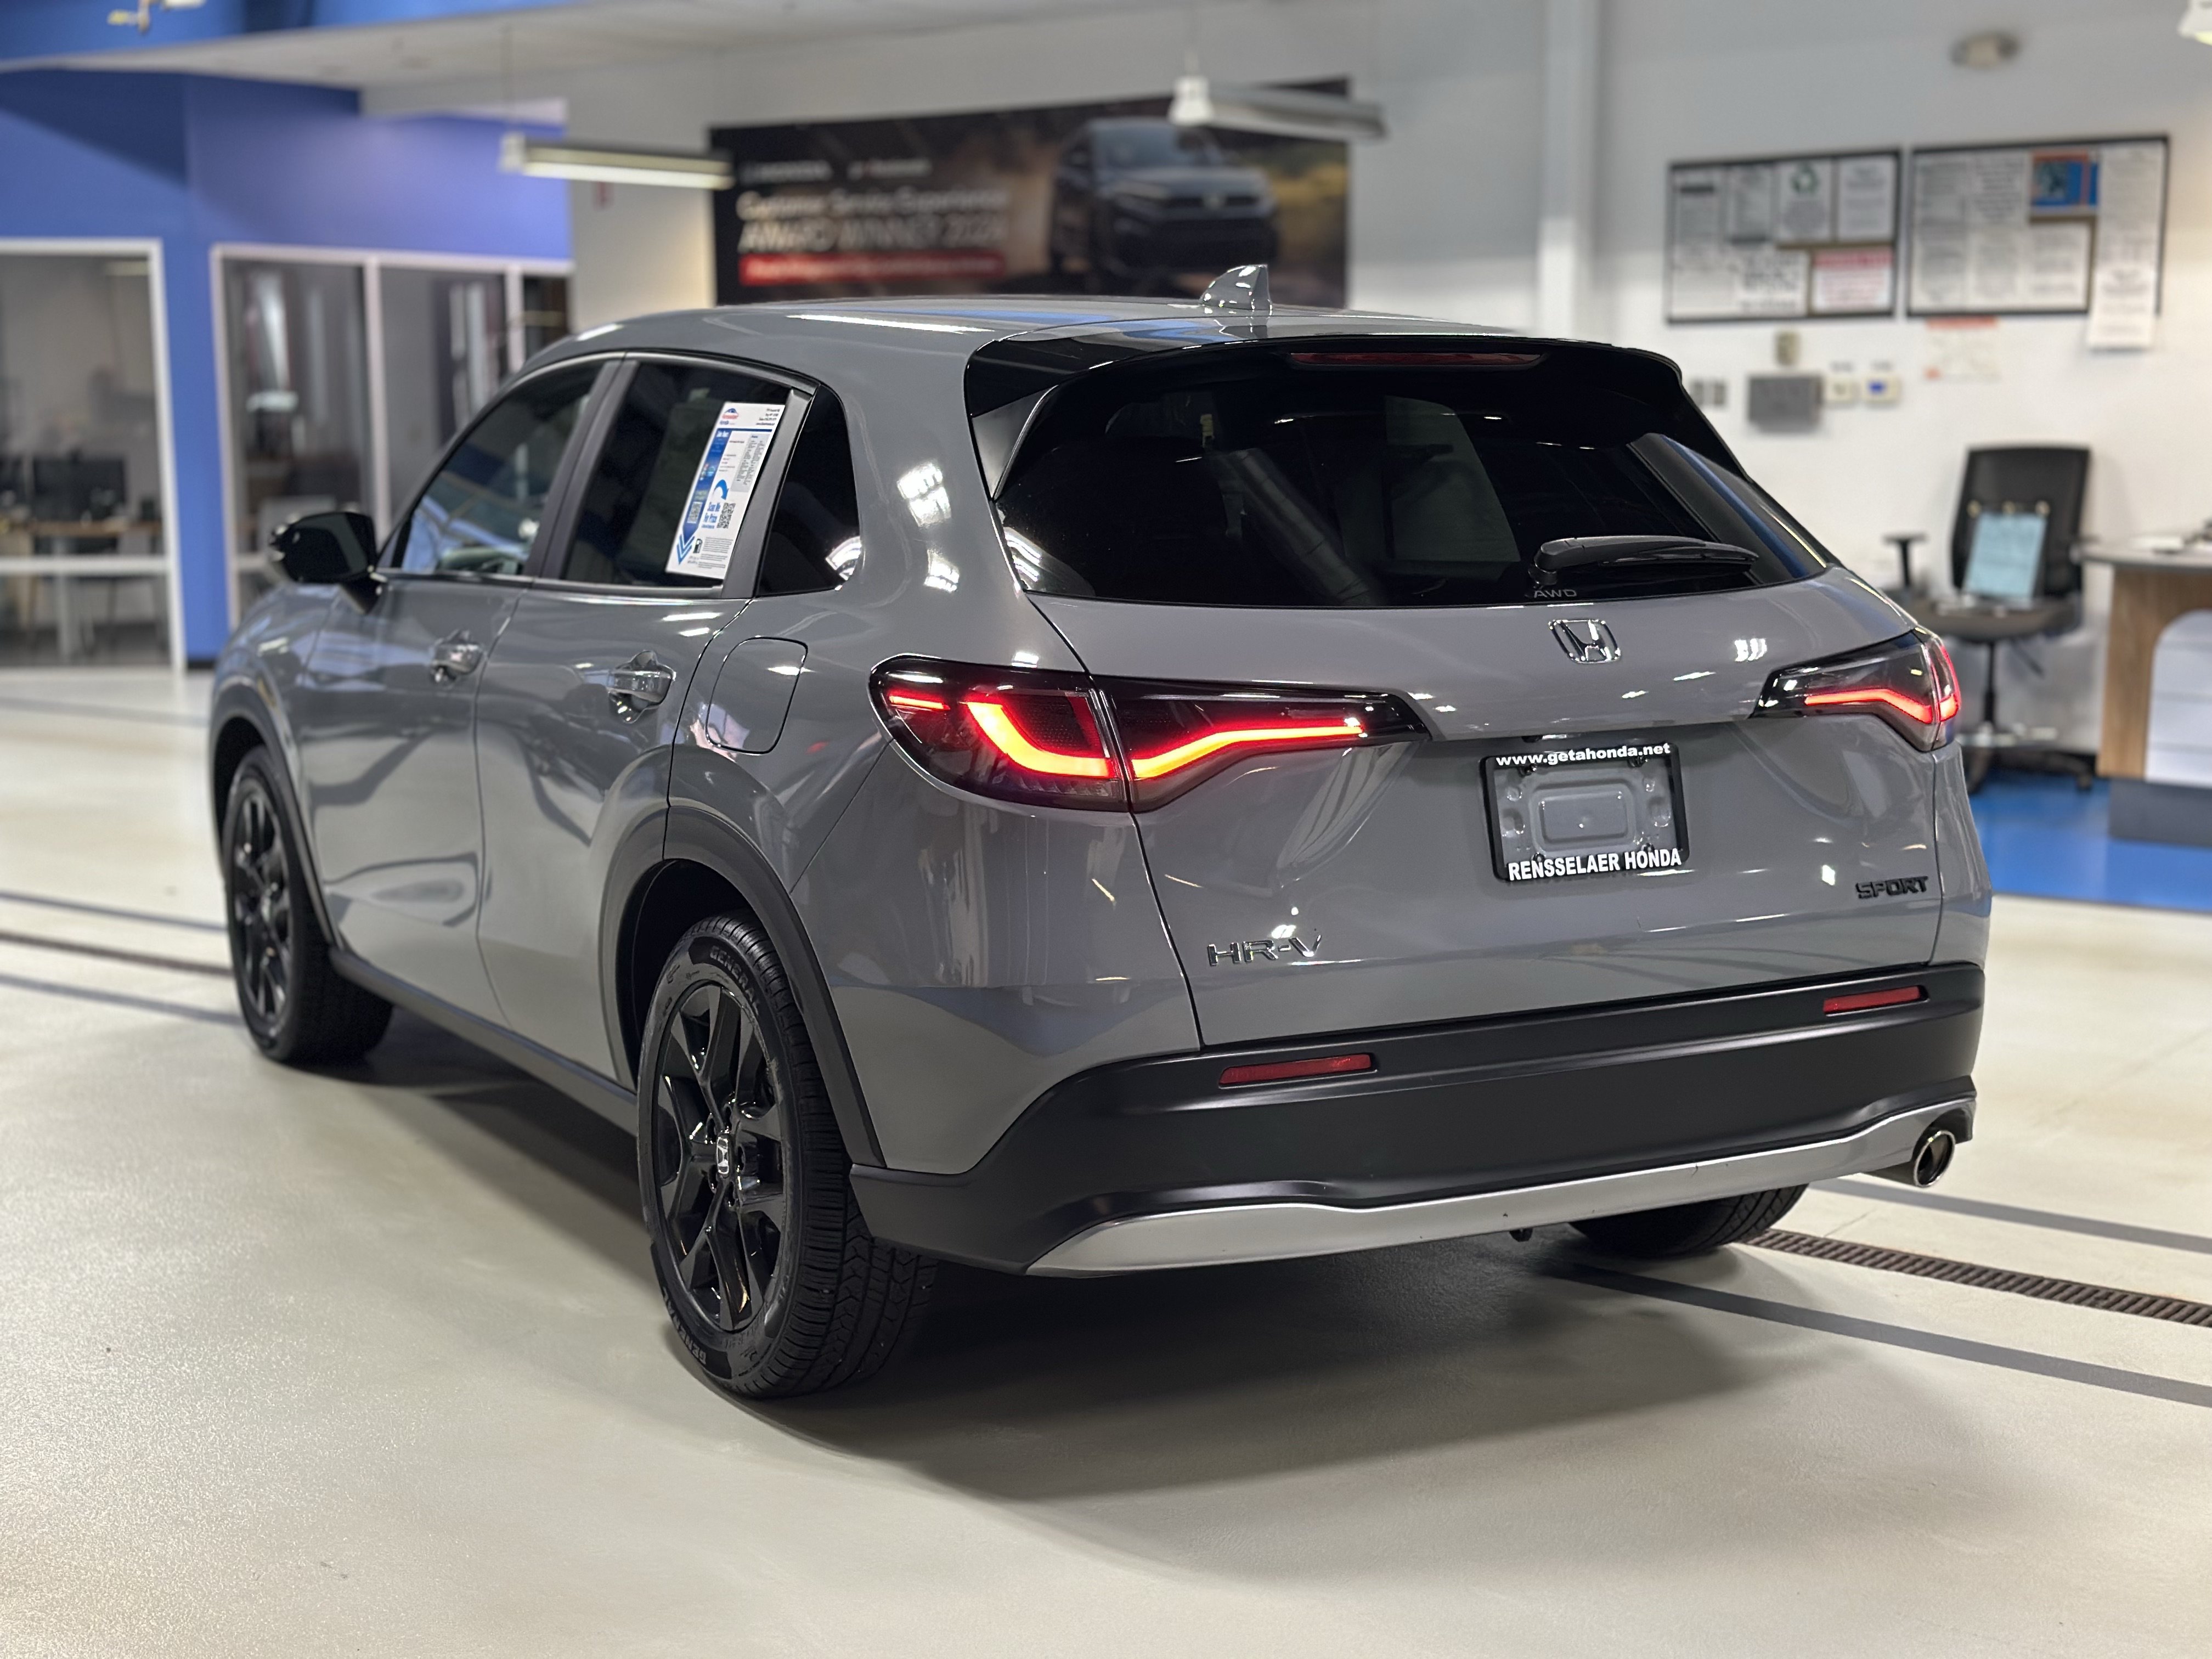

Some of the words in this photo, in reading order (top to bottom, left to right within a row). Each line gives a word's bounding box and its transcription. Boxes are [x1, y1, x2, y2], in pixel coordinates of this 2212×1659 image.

[1533, 589, 1577, 598] AWD
[1496, 743, 1671, 766] www.getahonda.net
[1508, 852, 1621, 881] RENSSELAER
[1624, 848, 1682, 870] HONDA
[1855, 876, 1928, 899] SPORT
[1207, 934, 1322, 966] HR-V
[709, 945, 760, 1018] GENERAL
